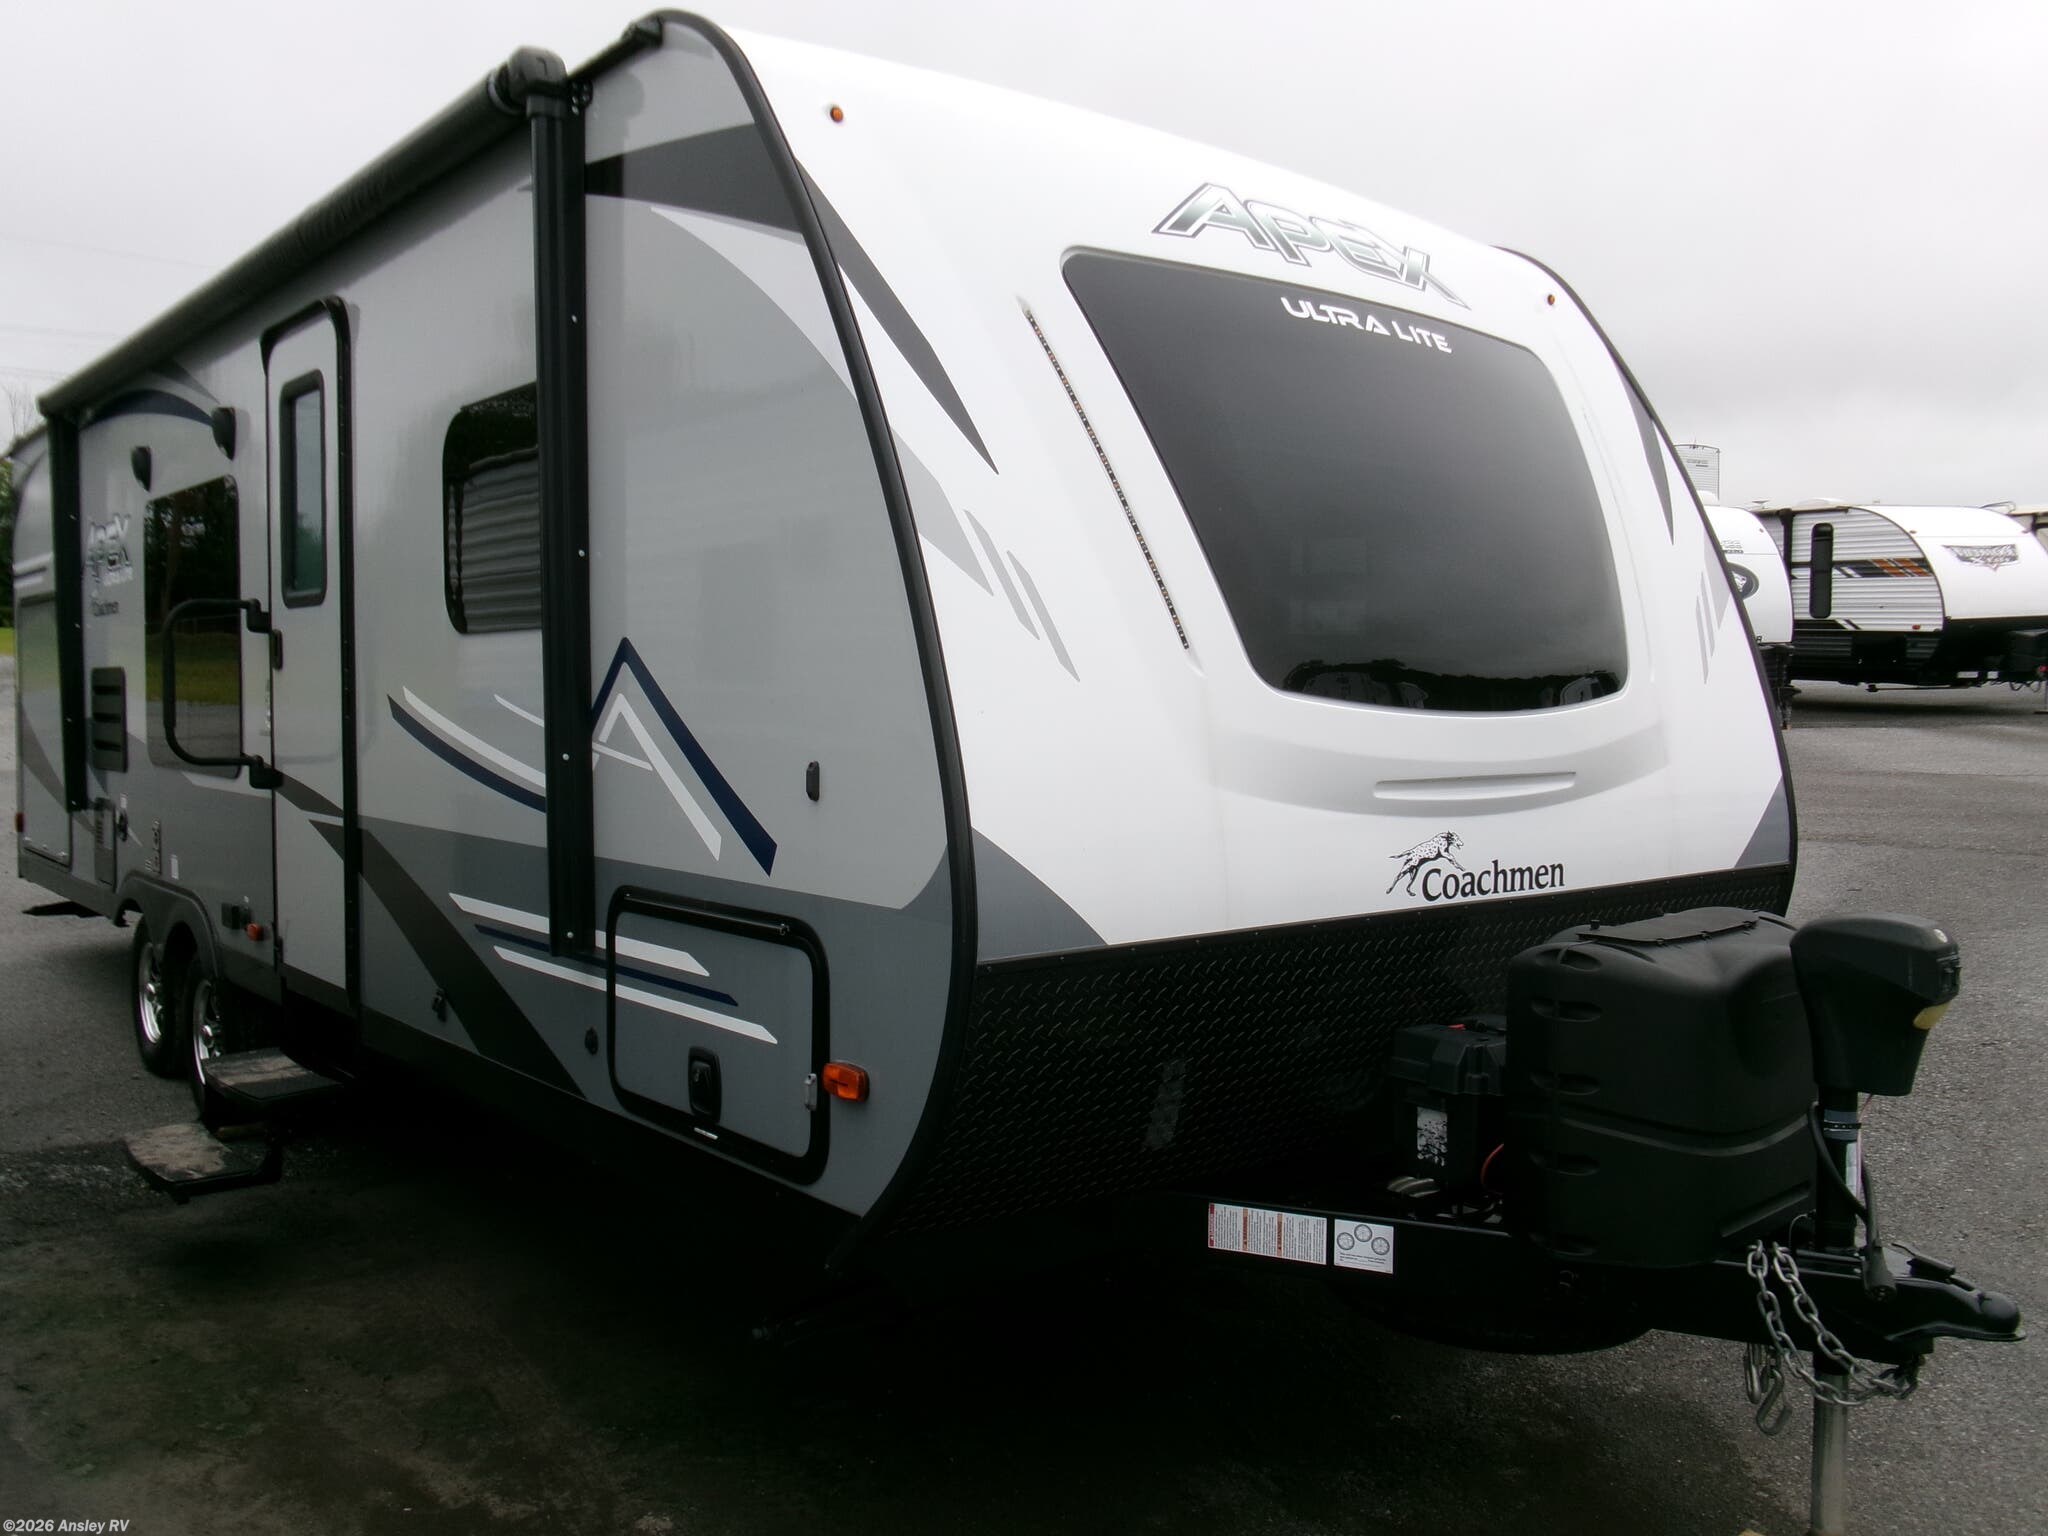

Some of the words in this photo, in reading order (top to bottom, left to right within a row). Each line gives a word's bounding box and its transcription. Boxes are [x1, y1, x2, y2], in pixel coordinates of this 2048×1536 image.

[1281, 297, 1390, 336] ULTRA
[1392, 320, 1452, 353] LITE
[1422, 860, 1564, 901] Coachmen
